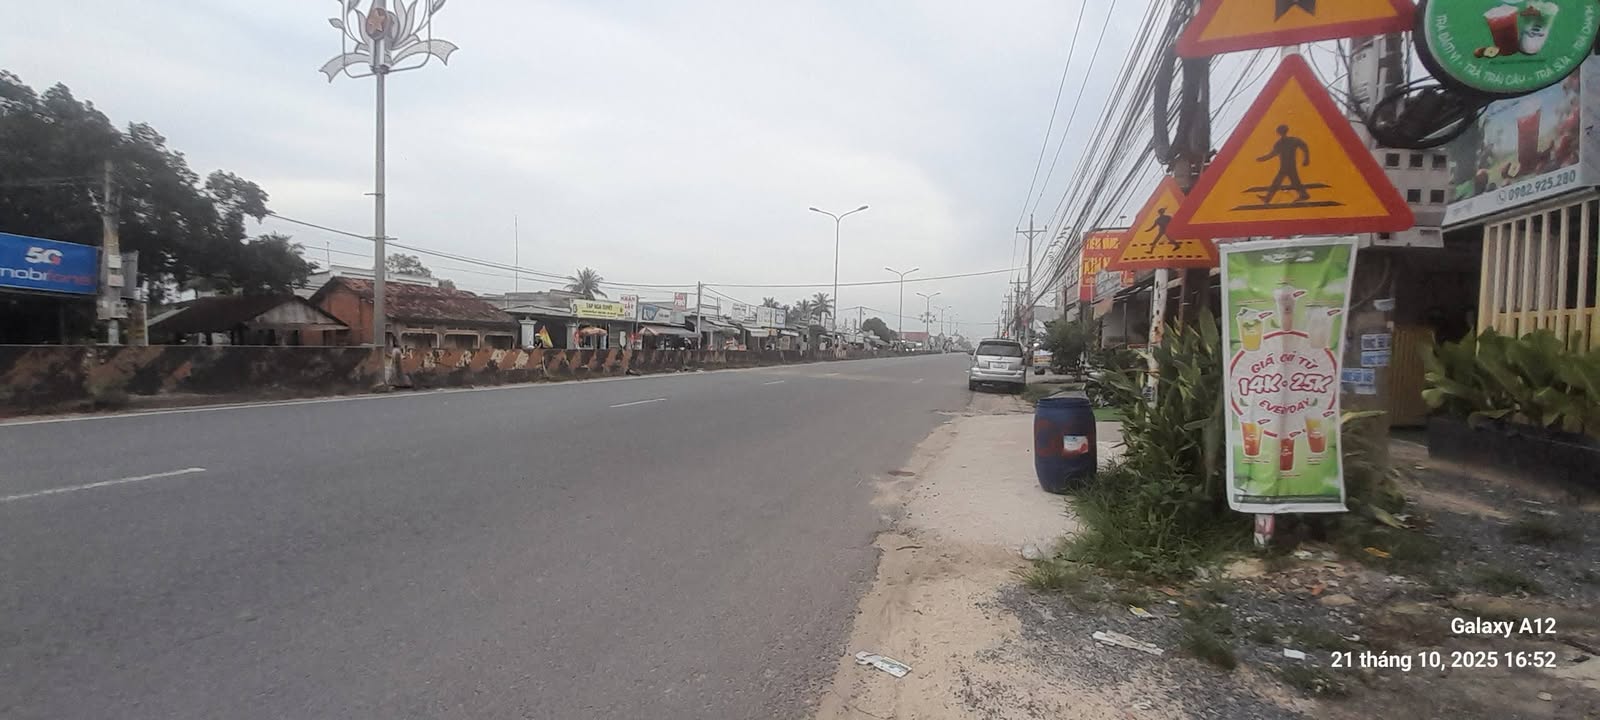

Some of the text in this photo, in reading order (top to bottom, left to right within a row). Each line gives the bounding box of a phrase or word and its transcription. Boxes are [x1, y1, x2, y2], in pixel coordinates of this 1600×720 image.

[25, 246, 63, 265] 5G
[1251, 353, 1274, 373] GIÁ
[1239, 373, 1282, 397] 14K
[1289, 373, 1334, 393] 25K
